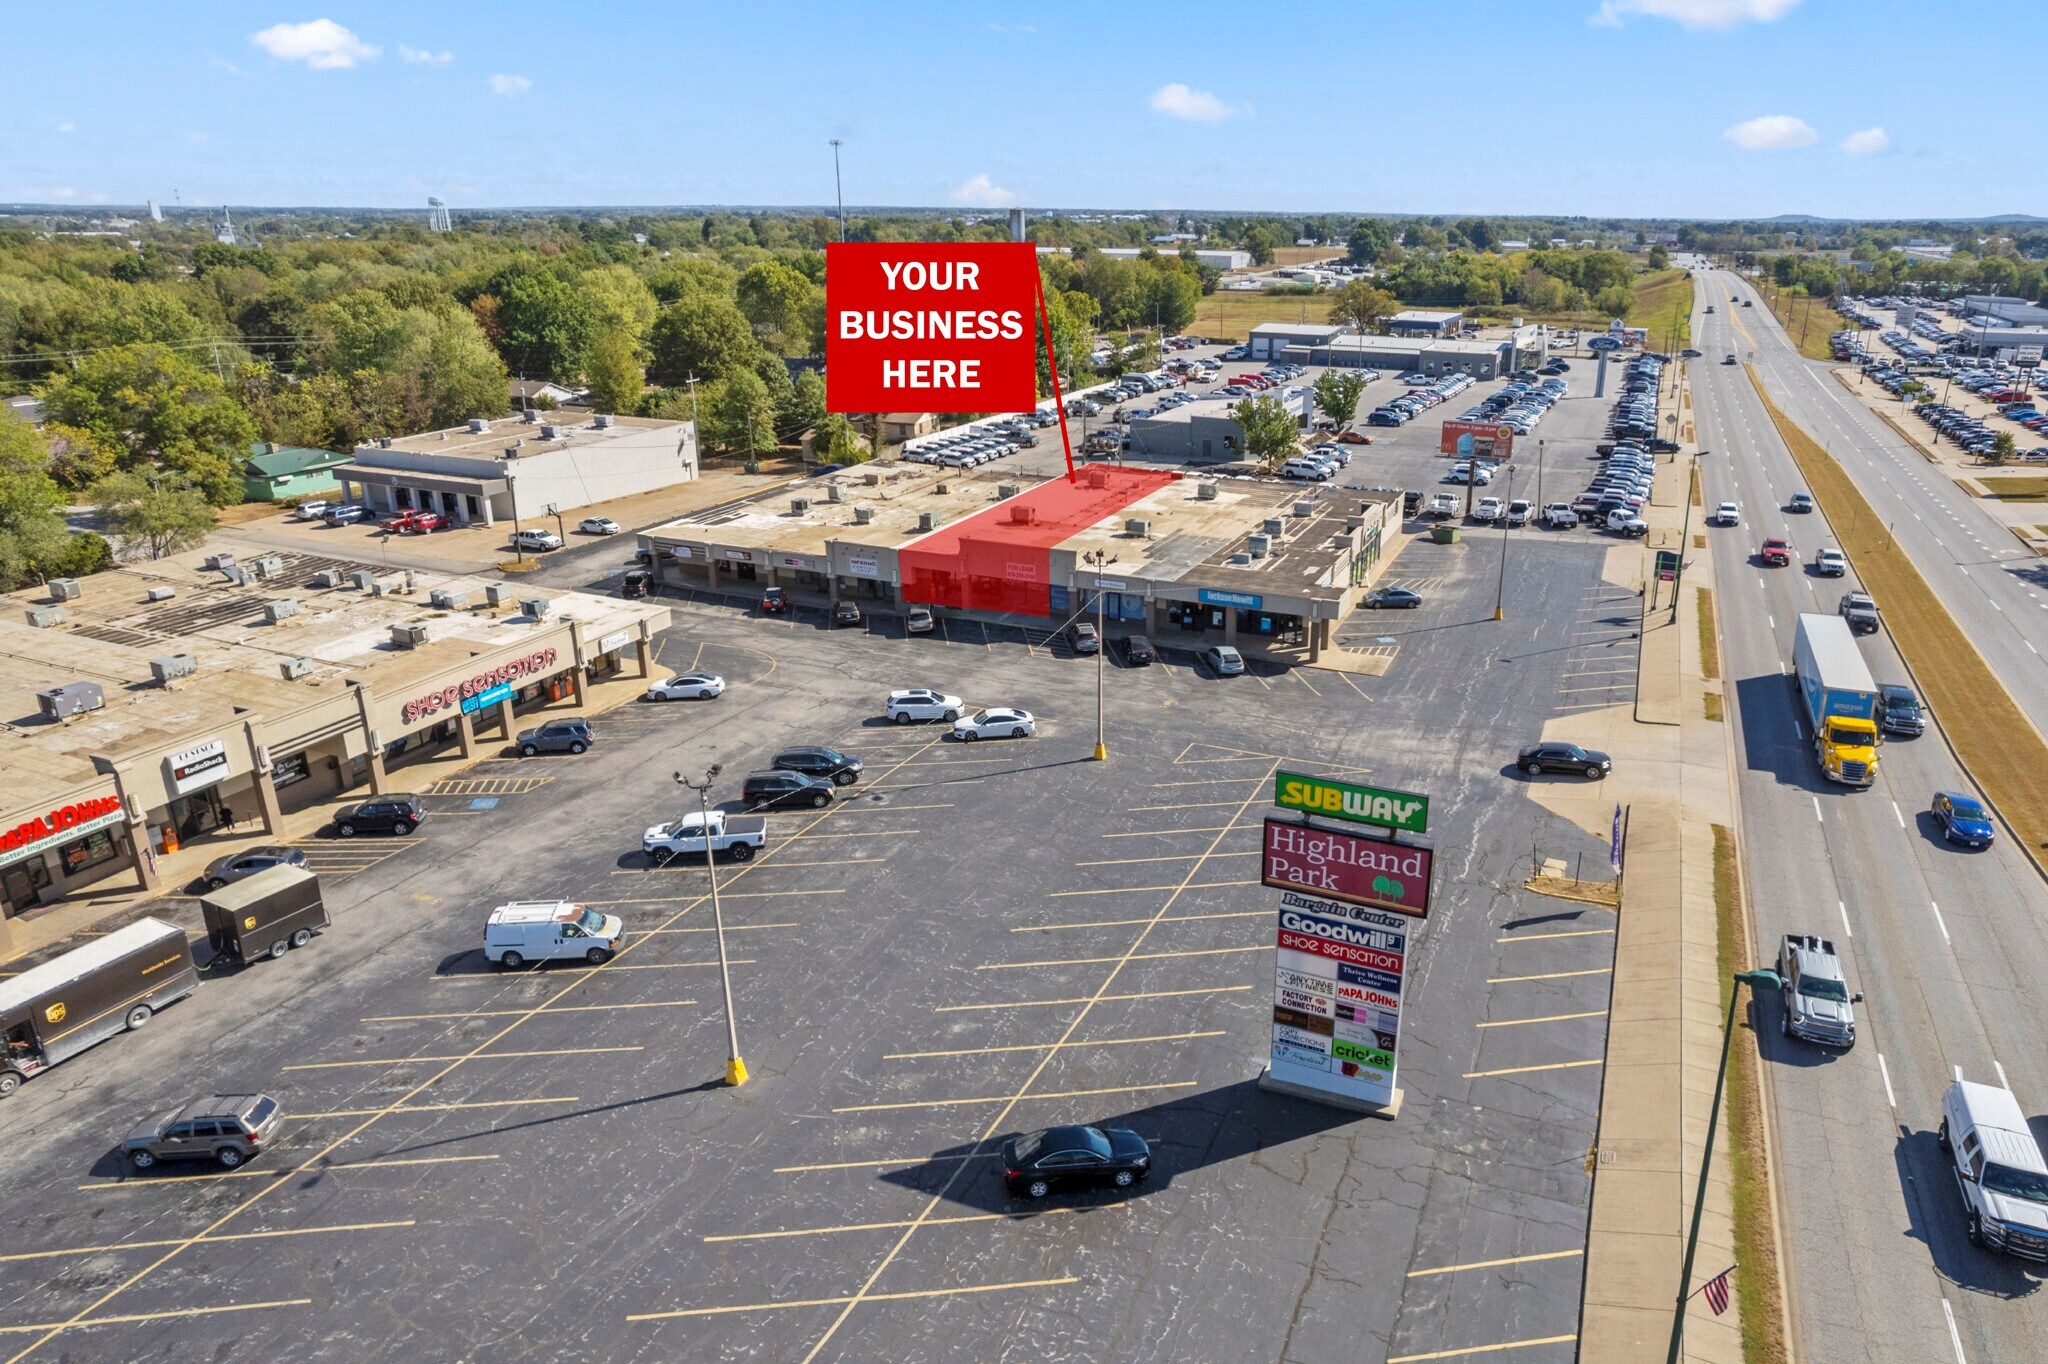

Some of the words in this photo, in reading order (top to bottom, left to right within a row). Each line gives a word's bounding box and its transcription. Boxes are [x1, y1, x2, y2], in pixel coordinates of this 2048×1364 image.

[1594, 340, 1615, 350] Ford
[1019, 565, 1035, 573] LEASE
[1207, 590, 1232, 602] Jackson
[1833, 703, 1864, 712] amazon
[184, 756, 224, 775] RadioShack
[1280, 781, 1423, 824] SUBWAY
[48, 796, 122, 834] JOHNS
[77, 821, 101, 834] Better
[1270, 826, 1423, 878] Highland
[1269, 857, 1340, 891] Park
[1282, 893, 1348, 916] Bargain
[1349, 906, 1405, 928] Center
[1282, 912, 1387, 950] Goodwill
[1290, 973, 1334, 989] ANYTIME
[1343, 966, 1366, 977] Thrive
[1367, 971, 1398, 984] Wellness
[1357, 976, 1382, 987] Center
[1282, 989, 1313, 1003] FACTORY
[1338, 987, 1363, 1001] PAPA
[1364, 990, 1398, 1009] JOHNS
[1282, 998, 1327, 1014] CONNECTION
[1279, 1026, 1299, 1036] COPY
[1336, 1045, 1391, 1067] cricket
